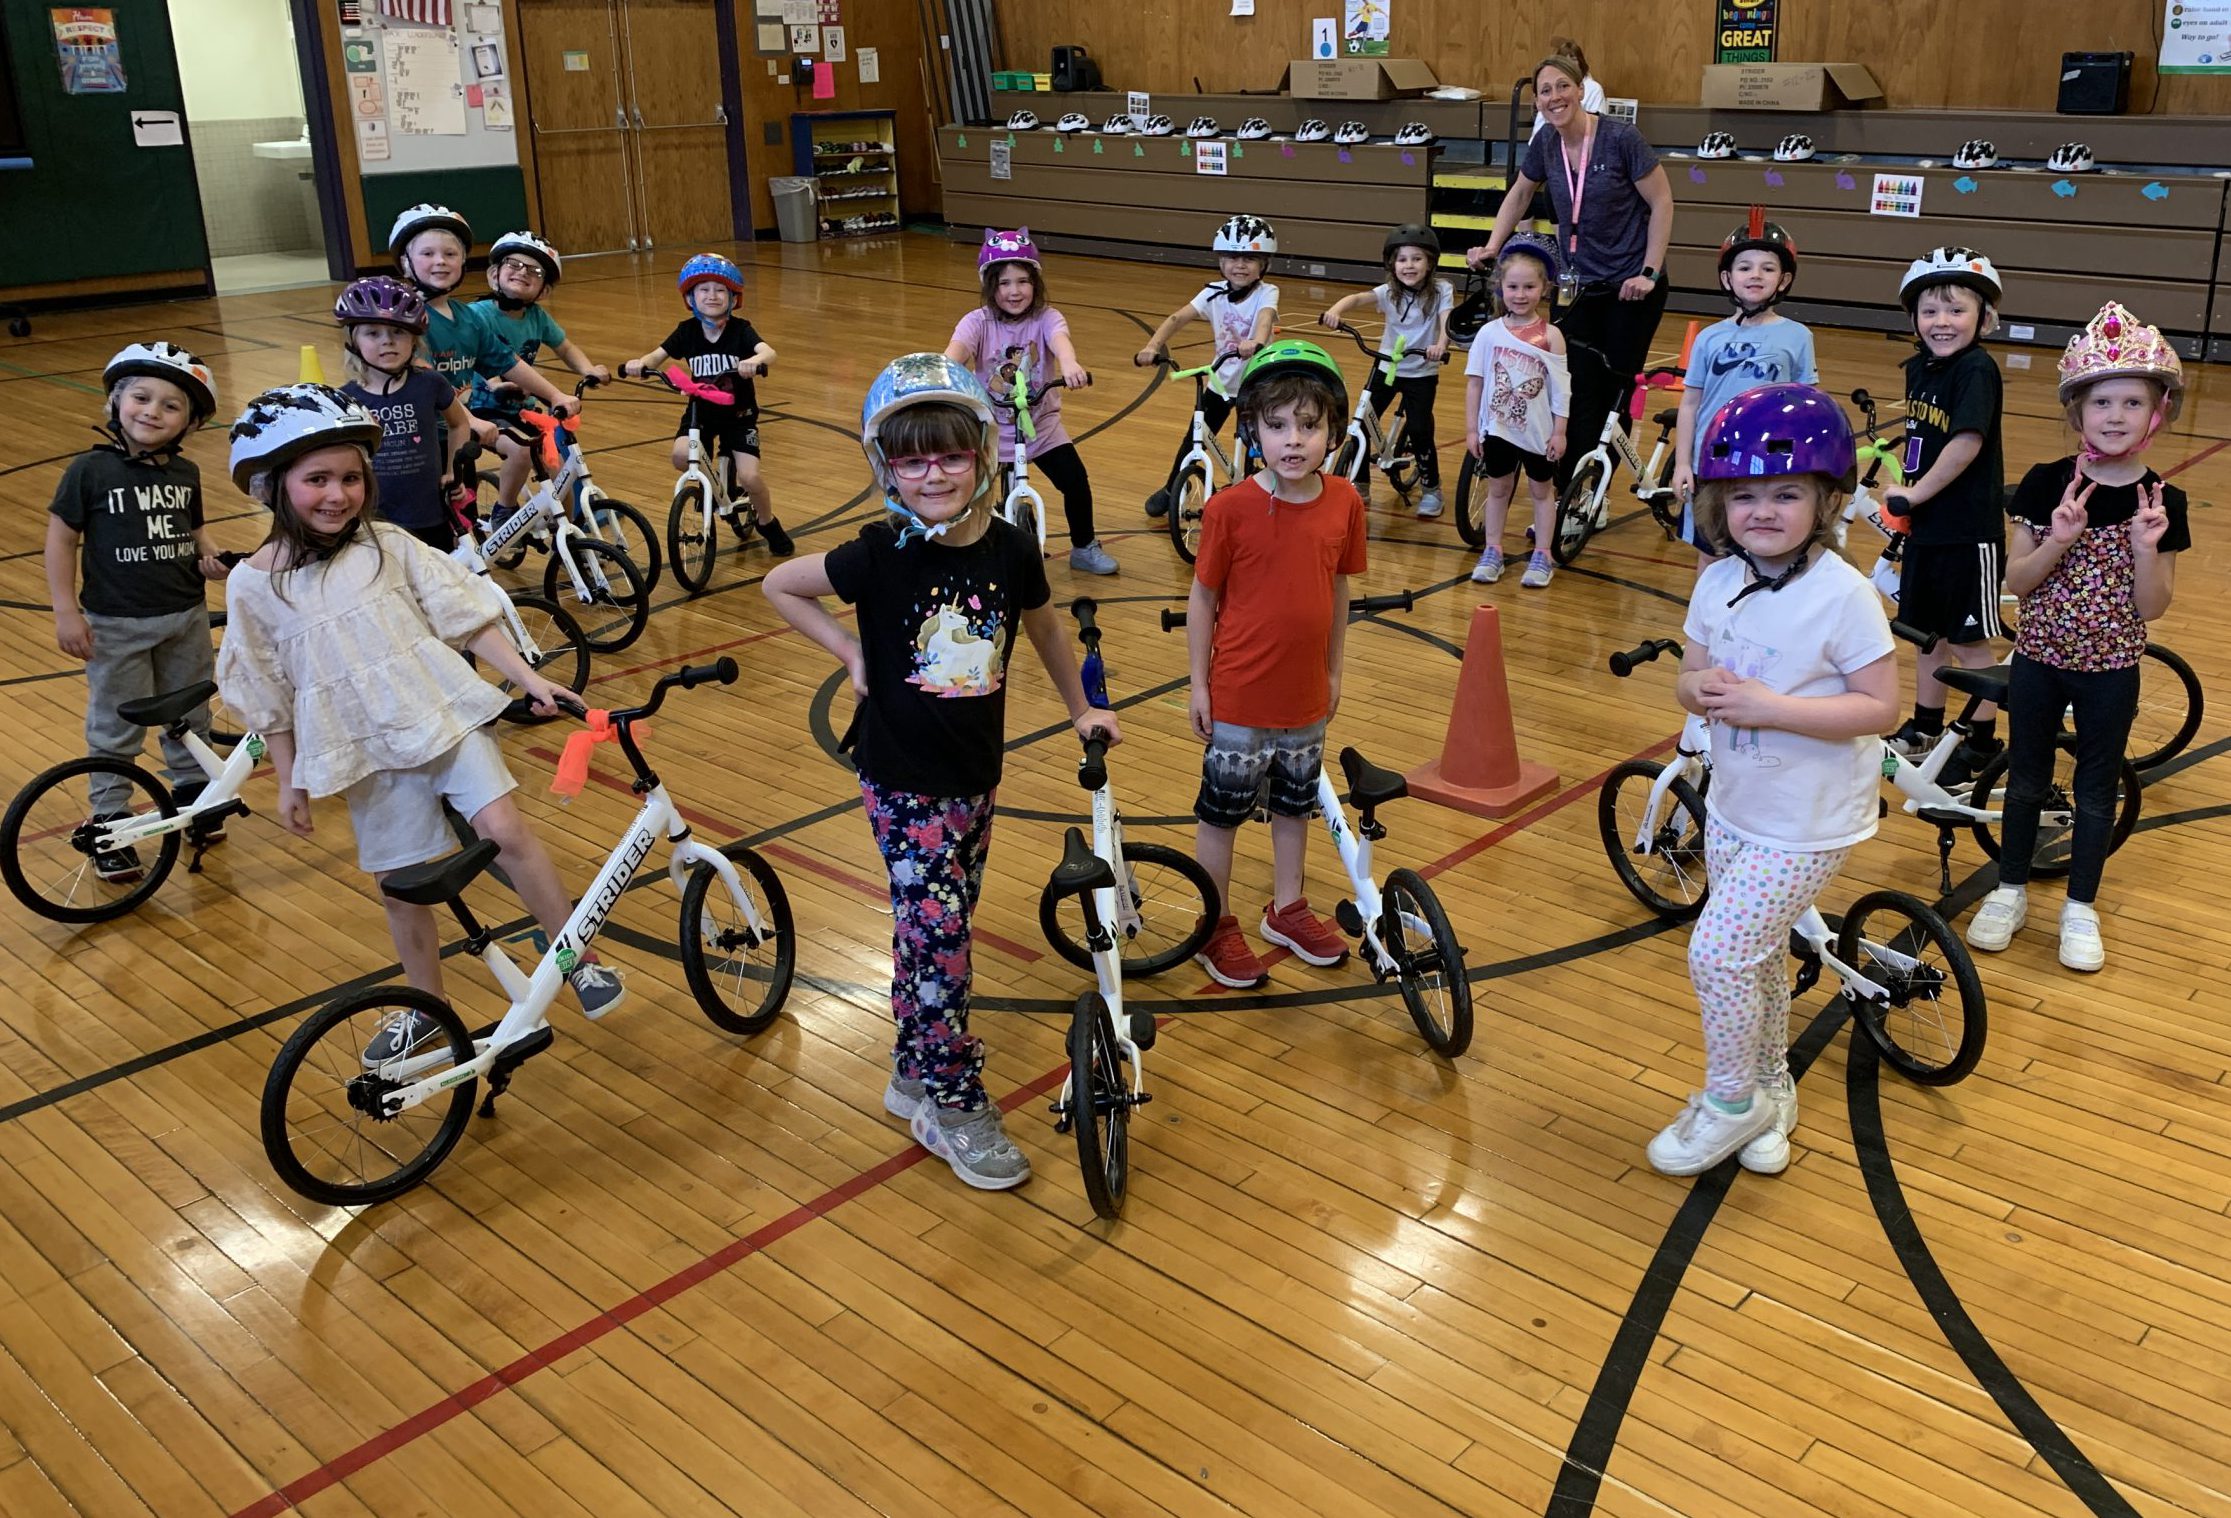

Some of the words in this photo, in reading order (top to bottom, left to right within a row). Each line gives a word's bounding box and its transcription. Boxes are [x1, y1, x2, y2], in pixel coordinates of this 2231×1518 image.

[1321, 27, 1328, 42] 1
[1721, 30, 1772, 47] GREAT
[1726, 52, 1766, 63] THINGS
[382, 419, 418, 437] ABE
[107, 487, 125, 514] IT
[146, 515, 190, 539] ME...
[485, 502, 539, 556] STRIDER
[115, 546, 149, 562] LOVE
[152, 544, 176, 560] YOU
[576, 827, 656, 947] STRIDER
